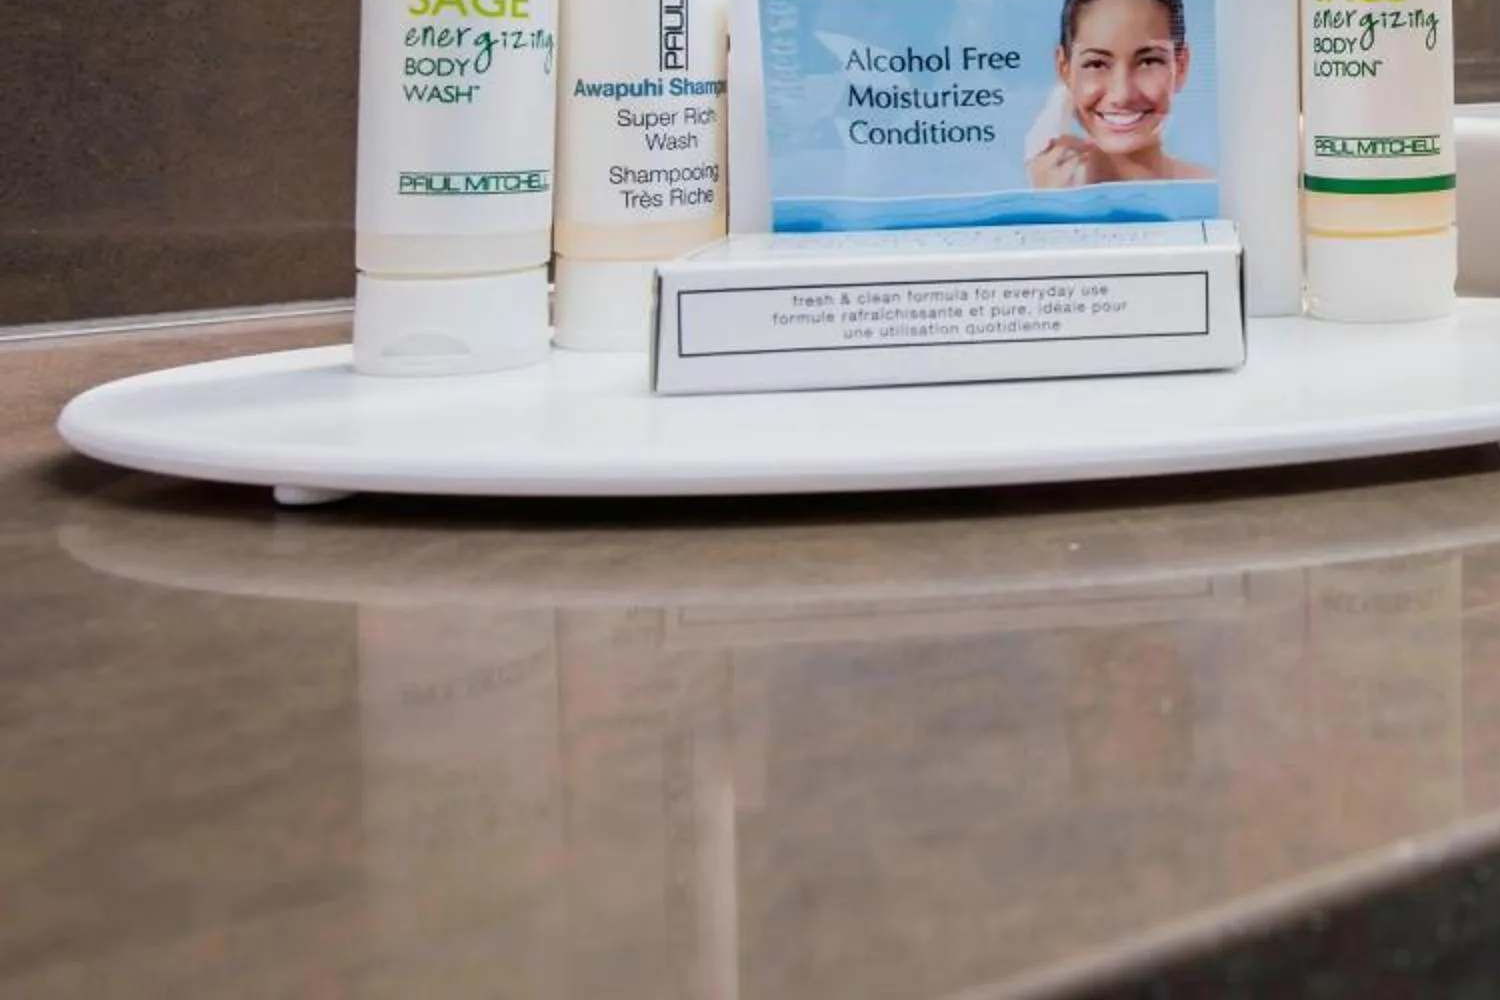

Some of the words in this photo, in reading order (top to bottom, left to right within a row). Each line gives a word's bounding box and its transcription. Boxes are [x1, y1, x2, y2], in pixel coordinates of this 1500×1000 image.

[1313, 8, 1440, 52] energizing
[404, 25, 554, 76] energizing
[1313, 36, 1358, 54] BODY
[404, 57, 471, 77] BODY
[845, 45, 950, 74] Alcohol
[962, 47, 1021, 71] Free
[573, 77, 663, 101] Awapuhi
[847, 84, 1005, 109] Moisturizes
[616, 108, 679, 130] Super
[644, 131, 698, 151] Wash
[848, 120, 996, 146] Conditions
[1358, 138, 1440, 155] MITCHELL
[399, 175, 461, 193] PAUL
[608, 161, 720, 187] Shampooing
[619, 189, 664, 209] Très
[669, 186, 714, 207] Riche
[792, 293, 833, 307] fresh
[839, 291, 851, 306] &
[857, 289, 901, 305] clean
[906, 287, 969, 304] formula
[975, 287, 996, 301] for
[1003, 285, 1075, 302] everyday
[1081, 285, 1109, 298] use
[772, 311, 836, 326] formule
[968, 304, 984, 319] et
[1091, 300, 1128, 316] pour
[842, 328, 874, 340] une
[879, 323, 959, 339] utilisation
[965, 319, 1062, 336] quotidienne
